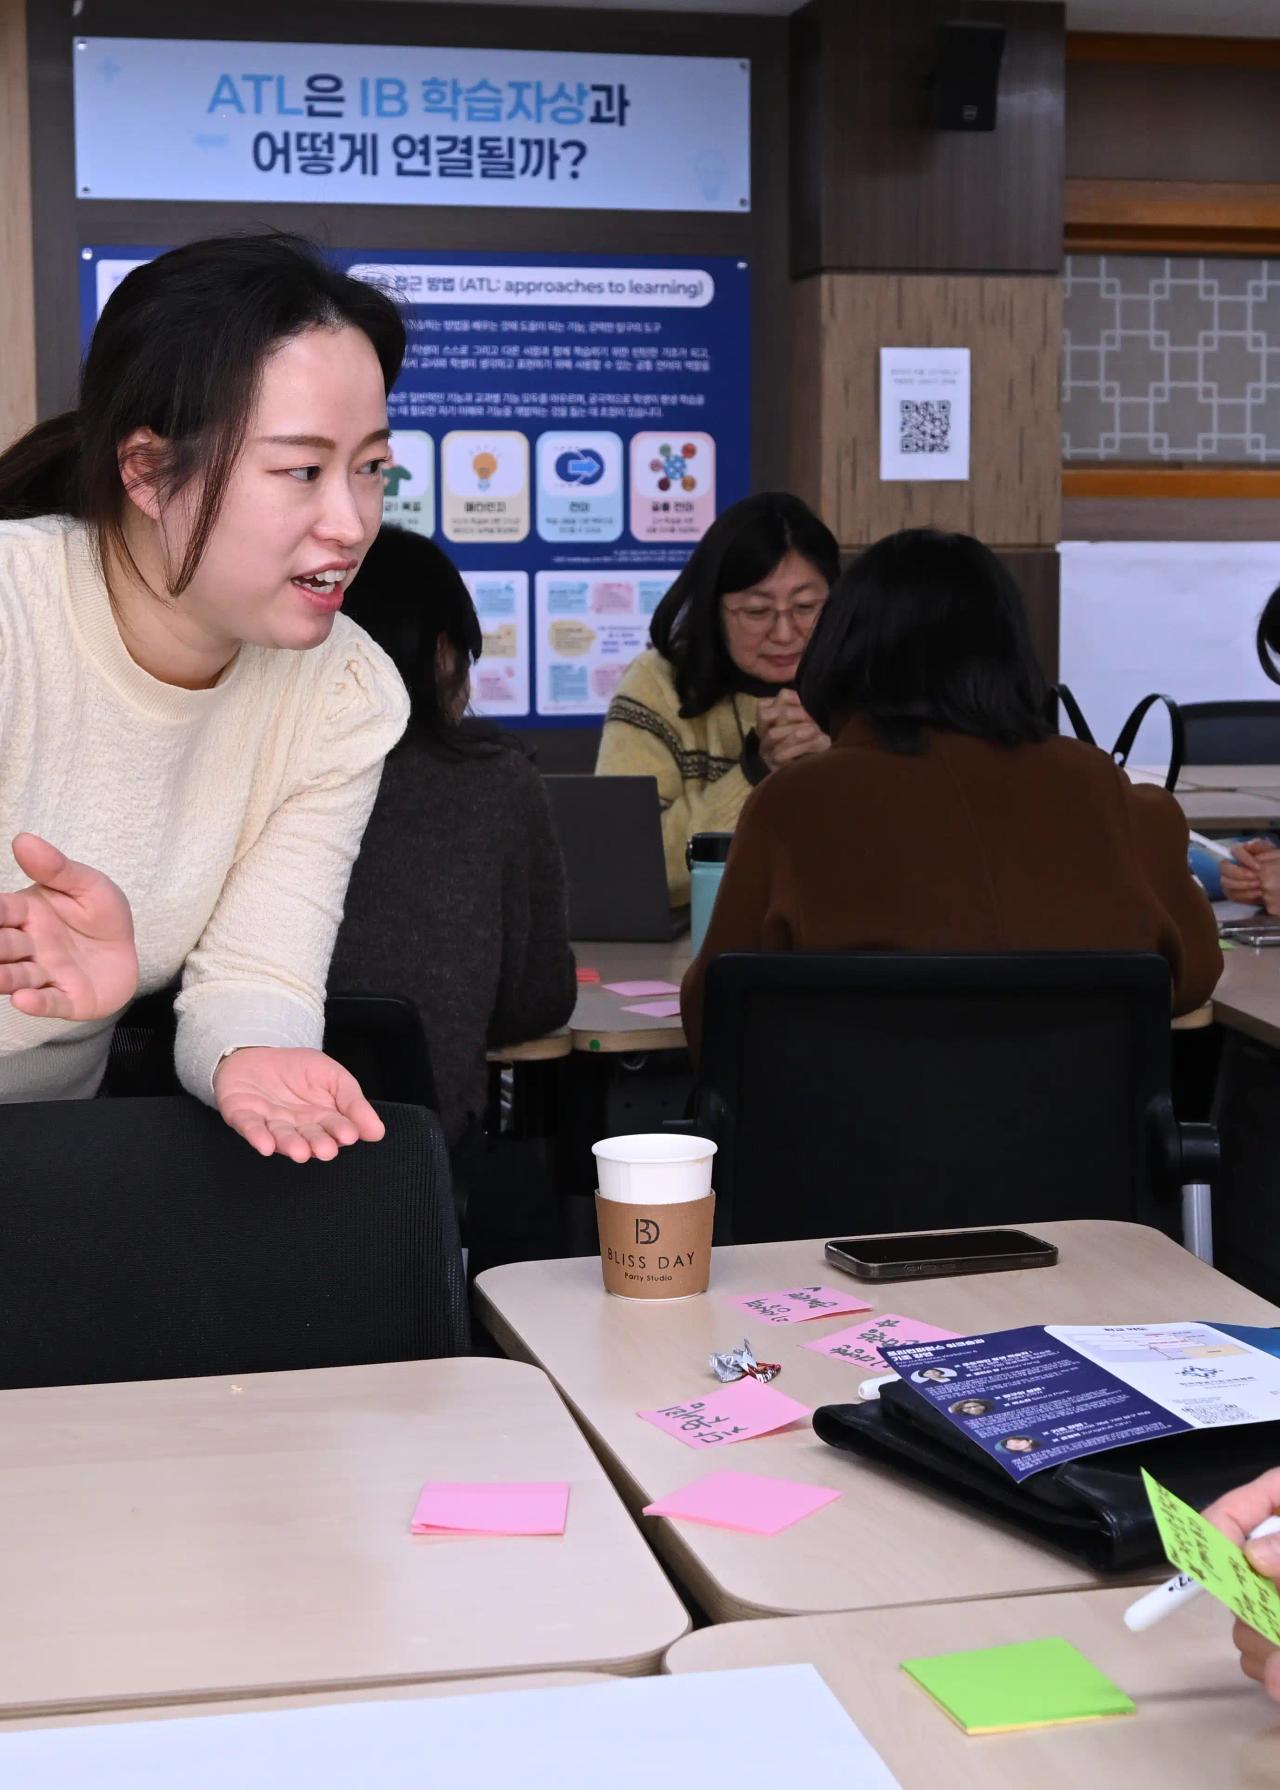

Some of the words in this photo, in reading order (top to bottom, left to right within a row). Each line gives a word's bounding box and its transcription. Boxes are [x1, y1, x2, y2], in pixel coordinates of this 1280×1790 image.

[206, 72, 346, 118] ATL은
[360, 77, 409, 118] IB
[420, 77, 631, 127] 학습자상과
[252, 131, 379, 177] 어떻게
[391, 133, 587, 180] 연결될까?
[504, 279, 604, 297] approaches
[607, 281, 626, 294] to
[628, 280, 704, 299] learning)
[607, 1247, 646, 1270] BLISS
[658, 1251, 695, 1270] DAY
[624, 1272, 644, 1283] Party
[646, 1273, 673, 1282] Studio
